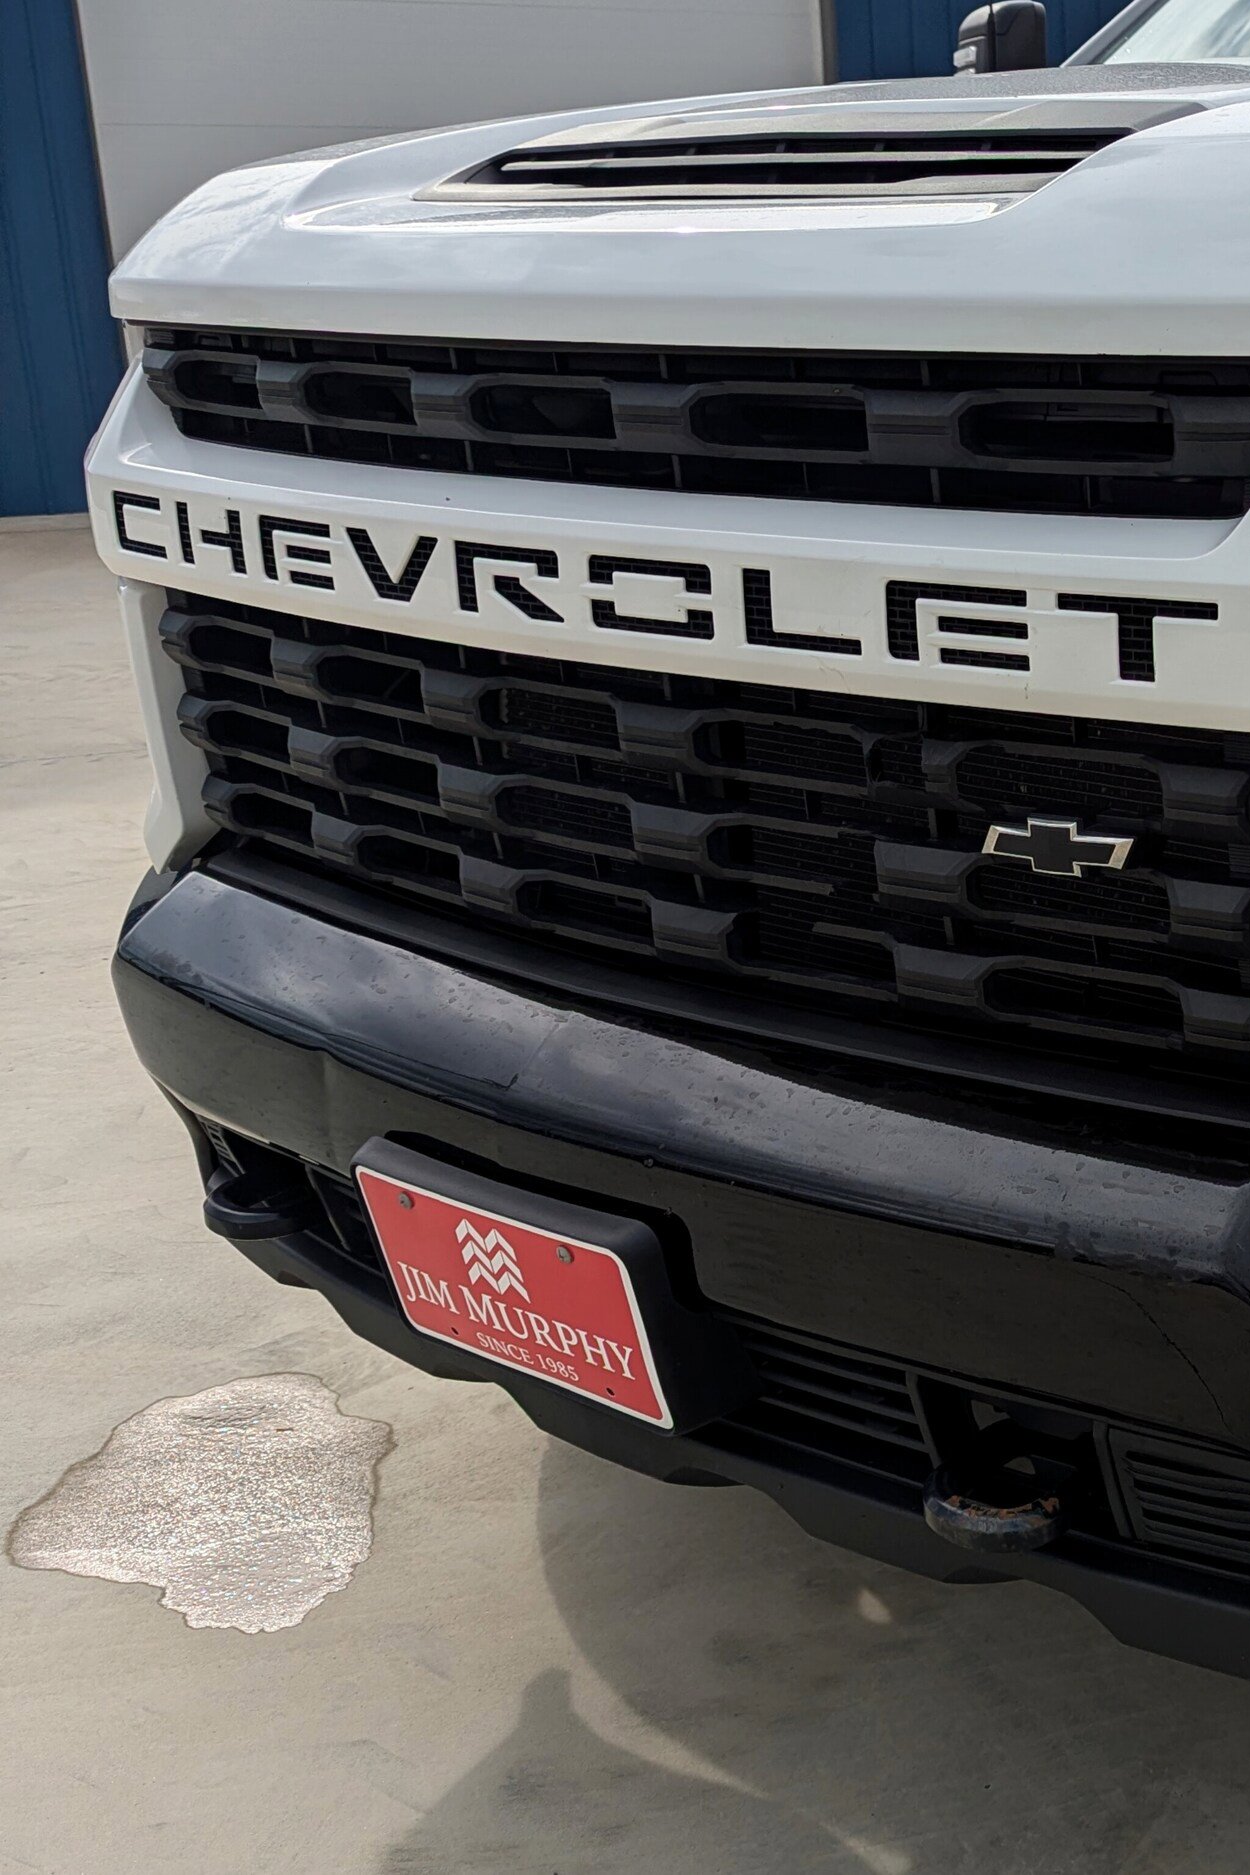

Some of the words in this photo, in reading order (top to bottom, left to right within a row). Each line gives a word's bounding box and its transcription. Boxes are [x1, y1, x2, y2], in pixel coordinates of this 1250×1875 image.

[113, 490, 1218, 682] CHEVROLET
[397, 1261, 460, 1315] JIM
[458, 1284, 636, 1381] MURPHY
[476, 1332, 534, 1365] SINCE
[536, 1353, 580, 1382] 1985
